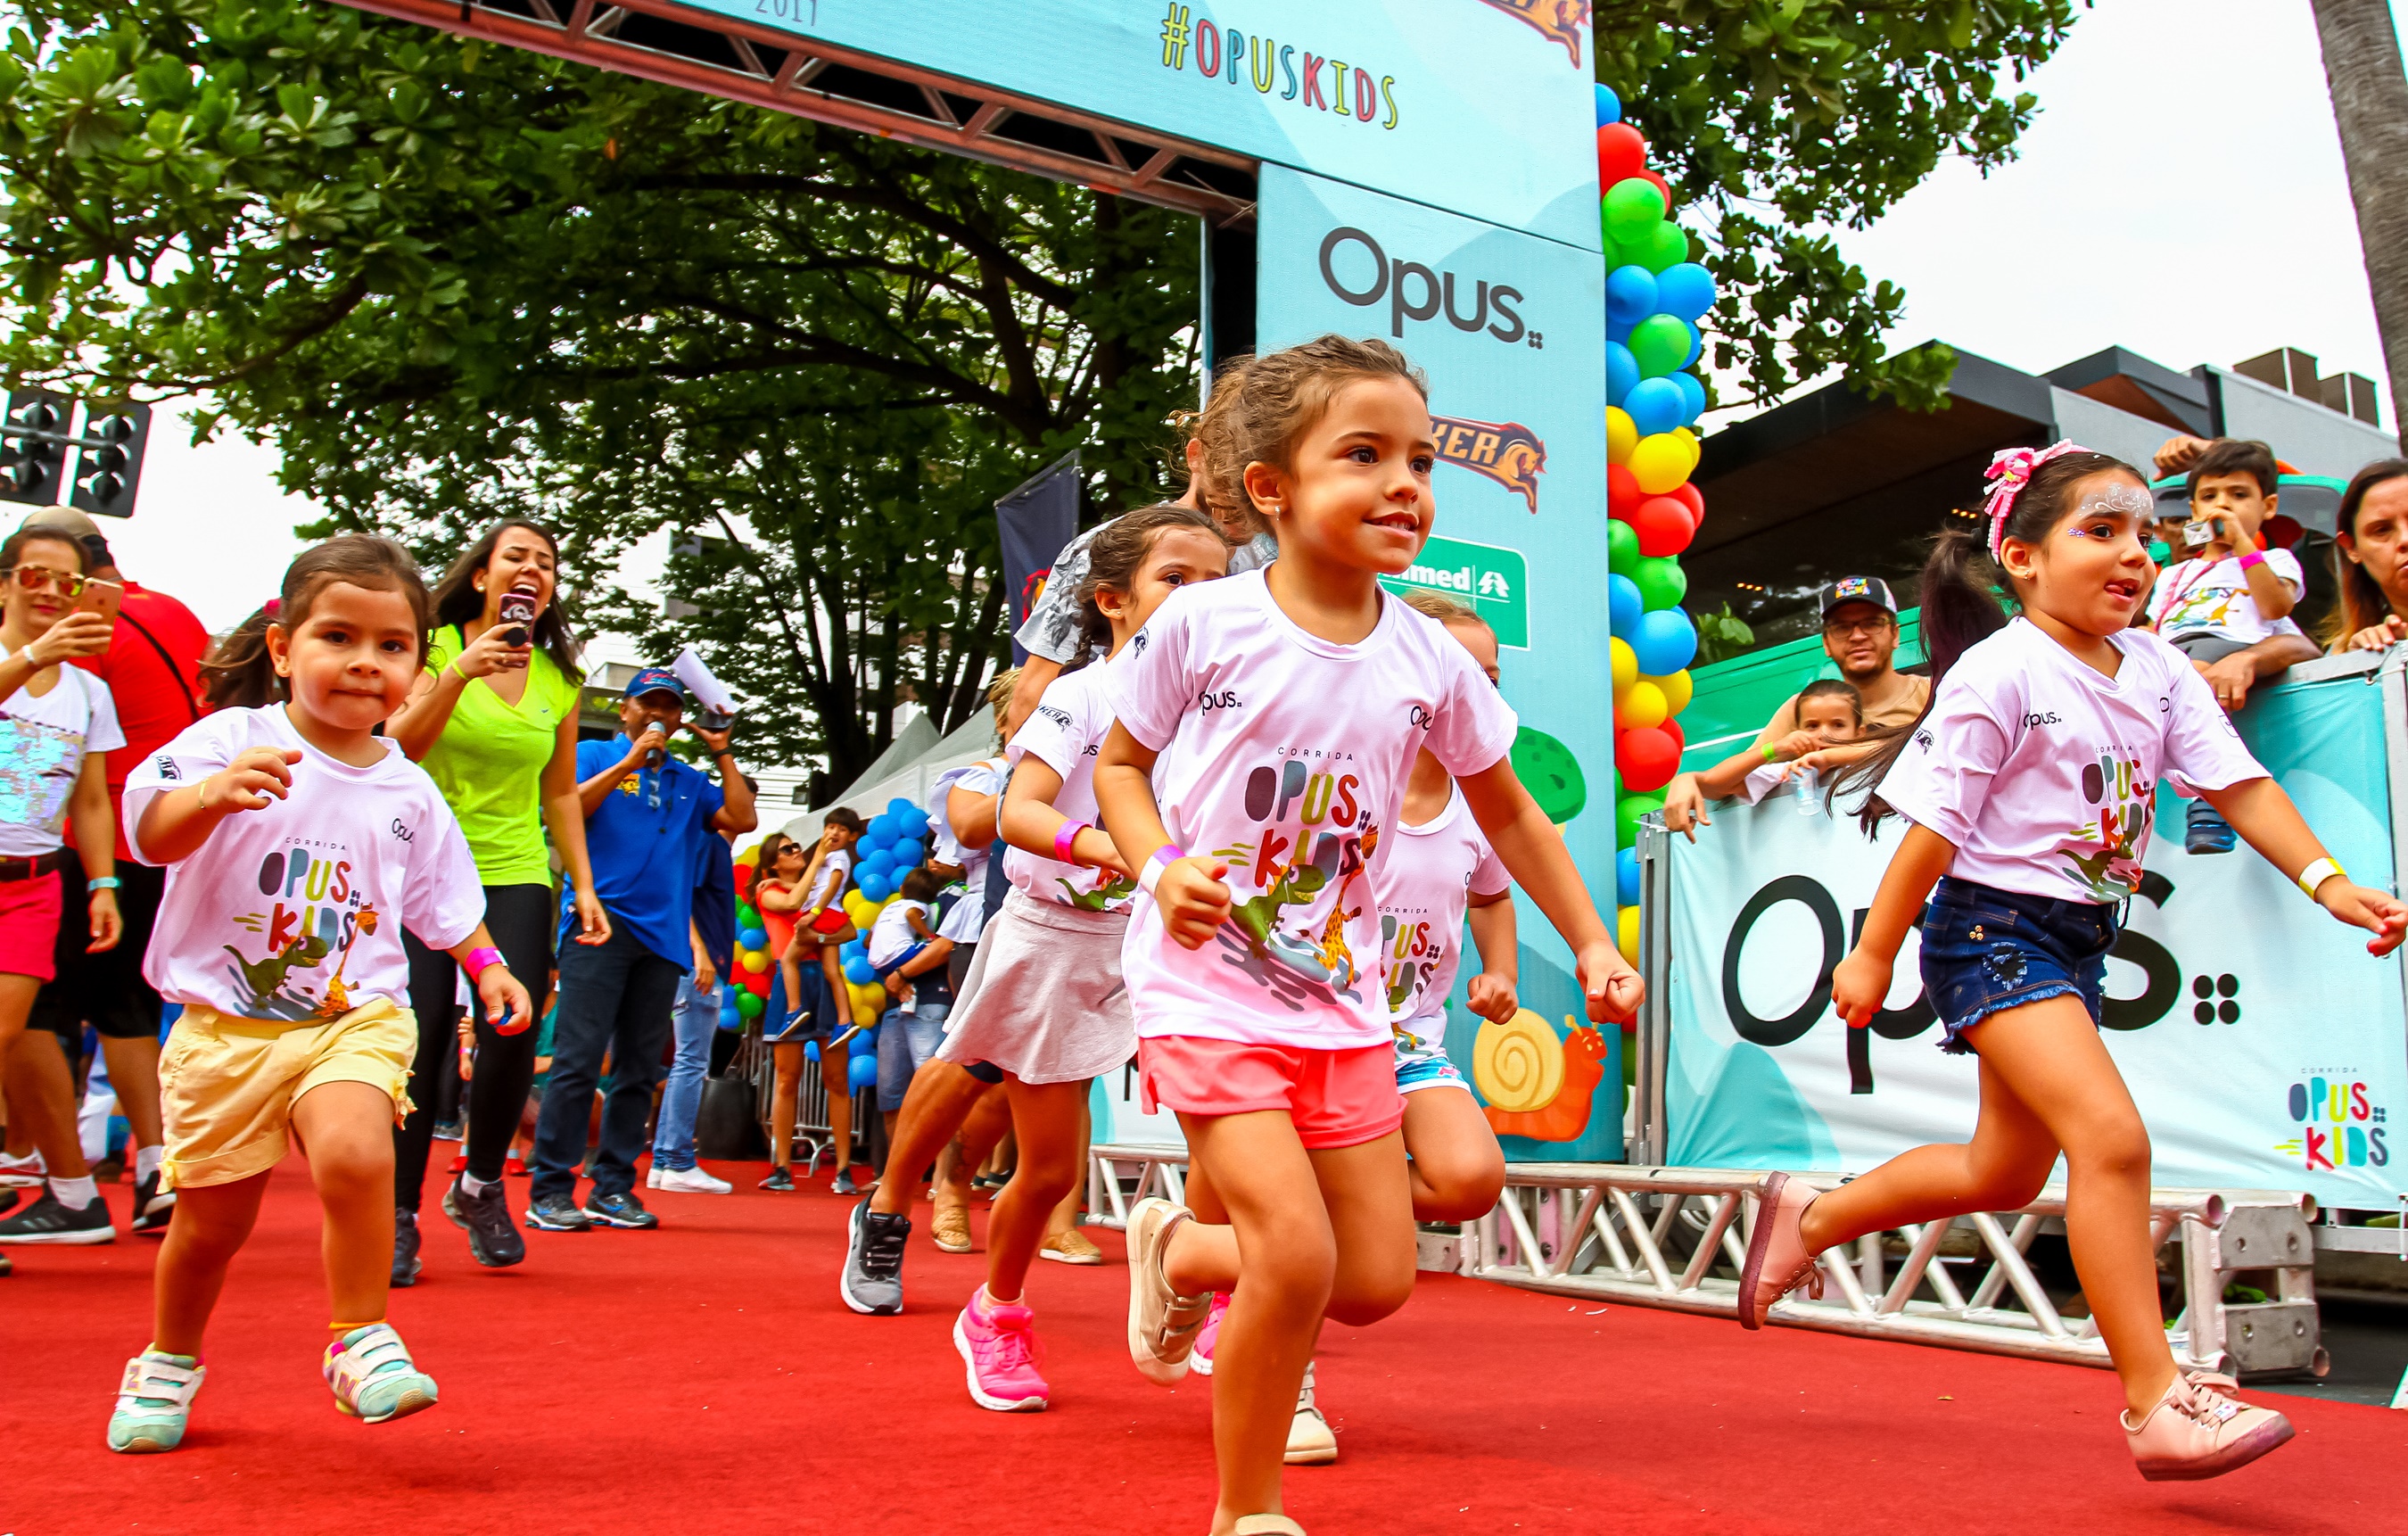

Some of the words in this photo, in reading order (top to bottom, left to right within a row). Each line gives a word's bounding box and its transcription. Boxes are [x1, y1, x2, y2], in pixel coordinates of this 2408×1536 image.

[1159, 2, 1398, 130] #OPUSKIDS
[1429, 420, 1502, 464] KER
[1278, 747, 1353, 761] CORRIDA
[1245, 760, 1359, 828] OPUS
[285, 837, 347, 850] CORRIDA
[259, 848, 351, 903] OPUS
[1381, 914, 1430, 960] PUS
[2288, 1077, 2370, 1122] OPUS
[2306, 1126, 2388, 1170] KIDS
